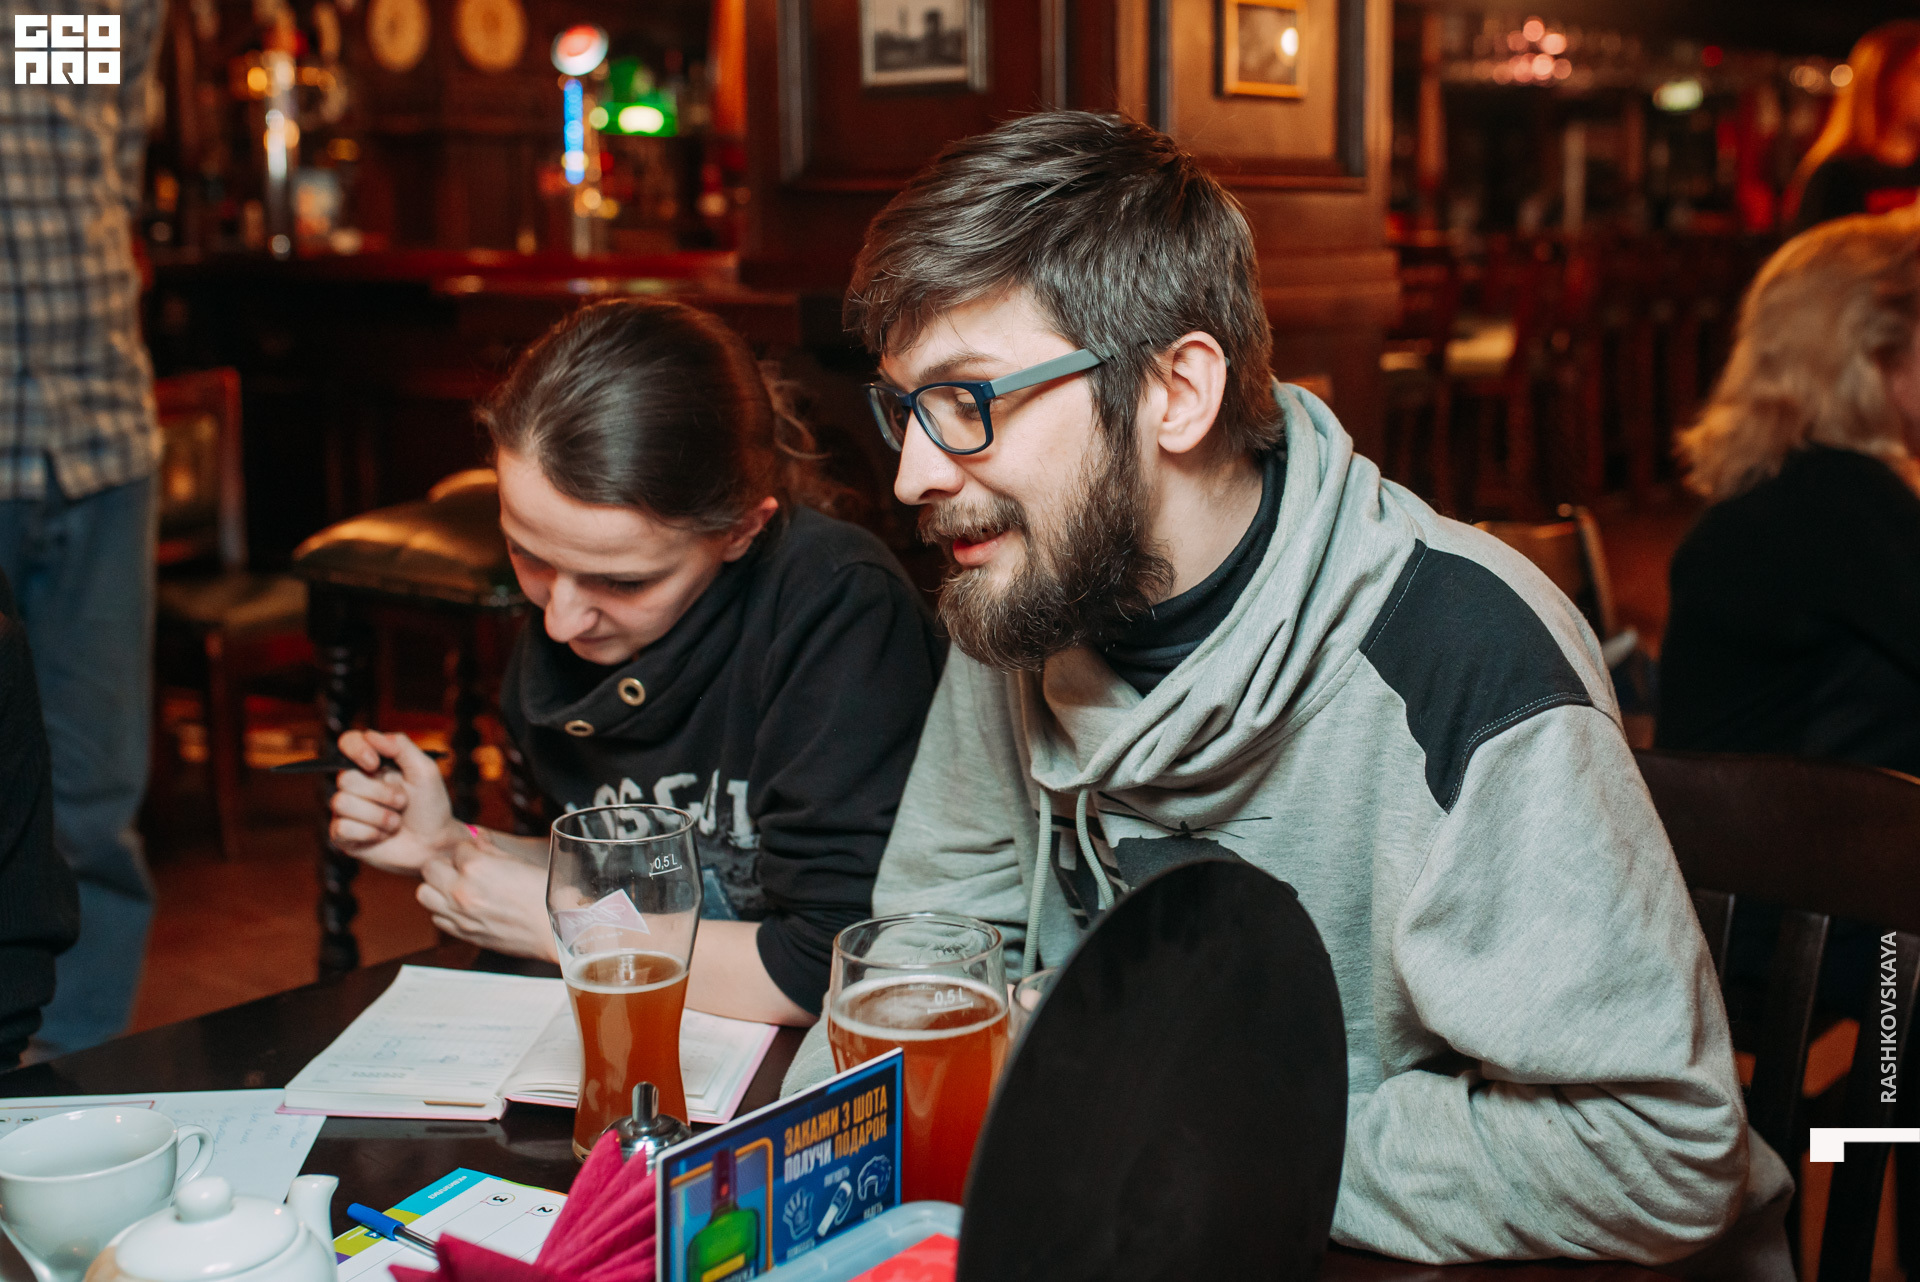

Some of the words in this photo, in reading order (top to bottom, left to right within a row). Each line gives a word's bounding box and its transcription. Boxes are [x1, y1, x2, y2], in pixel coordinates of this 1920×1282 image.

[784, 1106, 839, 1157] ЗАКАЖИ
[853, 1085, 888, 1125] ШОТА
[784, 1138, 832, 1184] ПОЛУЧИ
[834, 1112, 887, 1160] ПОДАРОК
